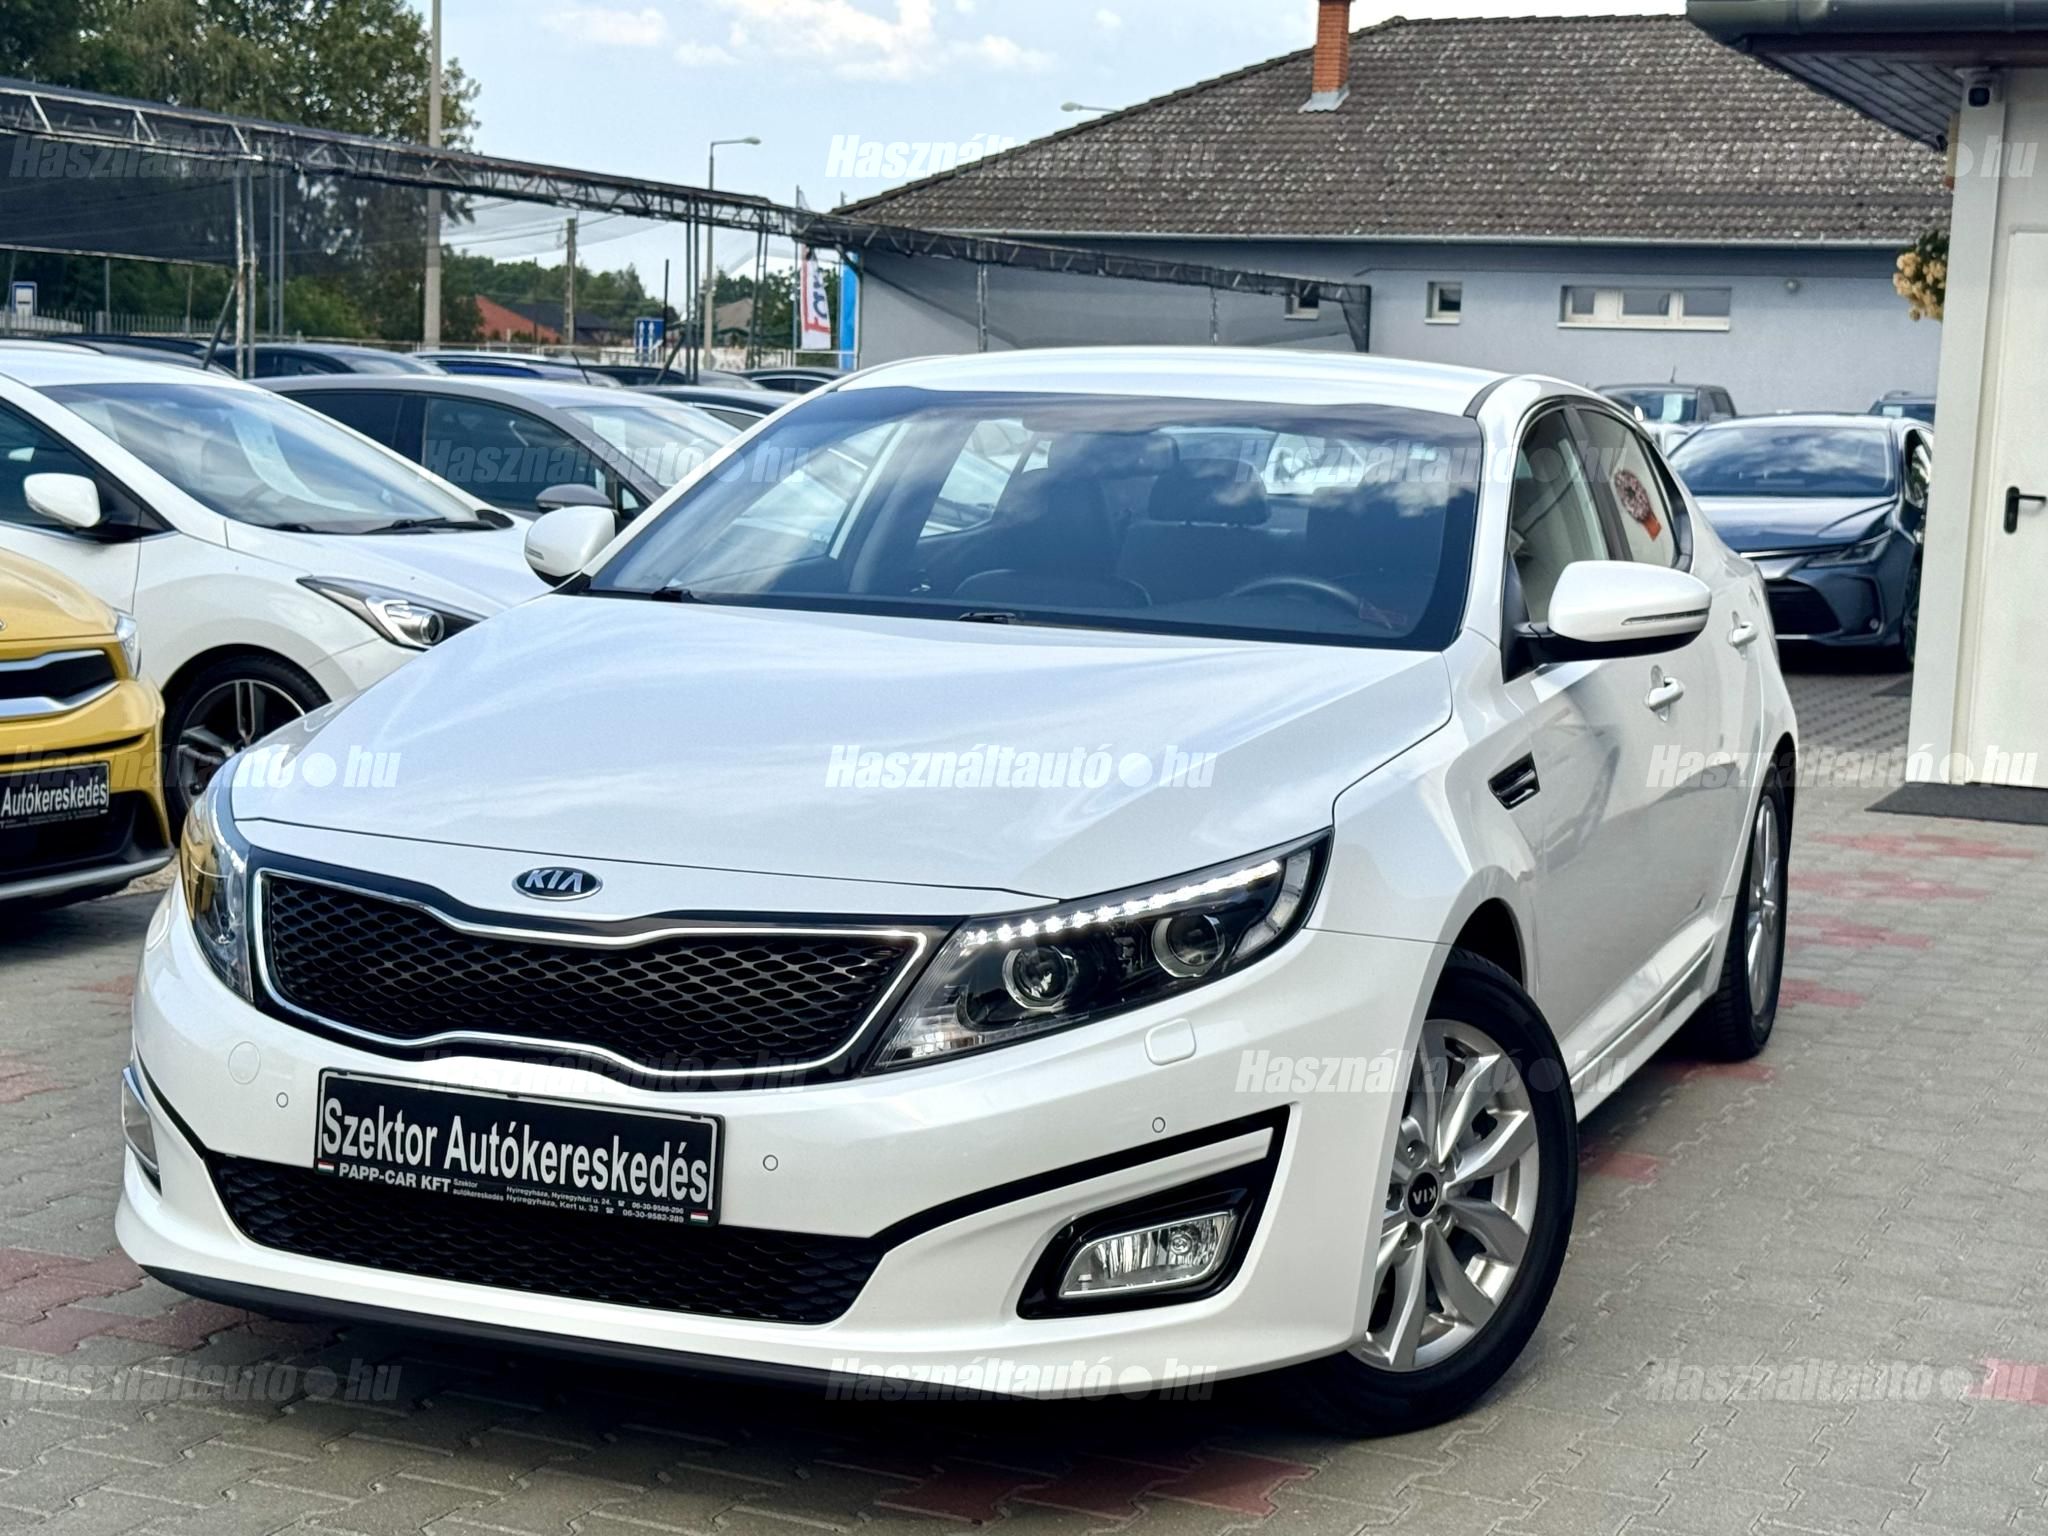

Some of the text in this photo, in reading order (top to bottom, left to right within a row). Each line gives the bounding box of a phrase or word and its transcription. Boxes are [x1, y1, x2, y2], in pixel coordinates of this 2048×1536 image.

[1, 776, 107, 817] Autókereskedés
[524, 869, 583, 893] KIA
[322, 1098, 709, 1203] Szektor Autókereskedés
[339, 1162, 452, 1193] PAPP-CAR KFT
